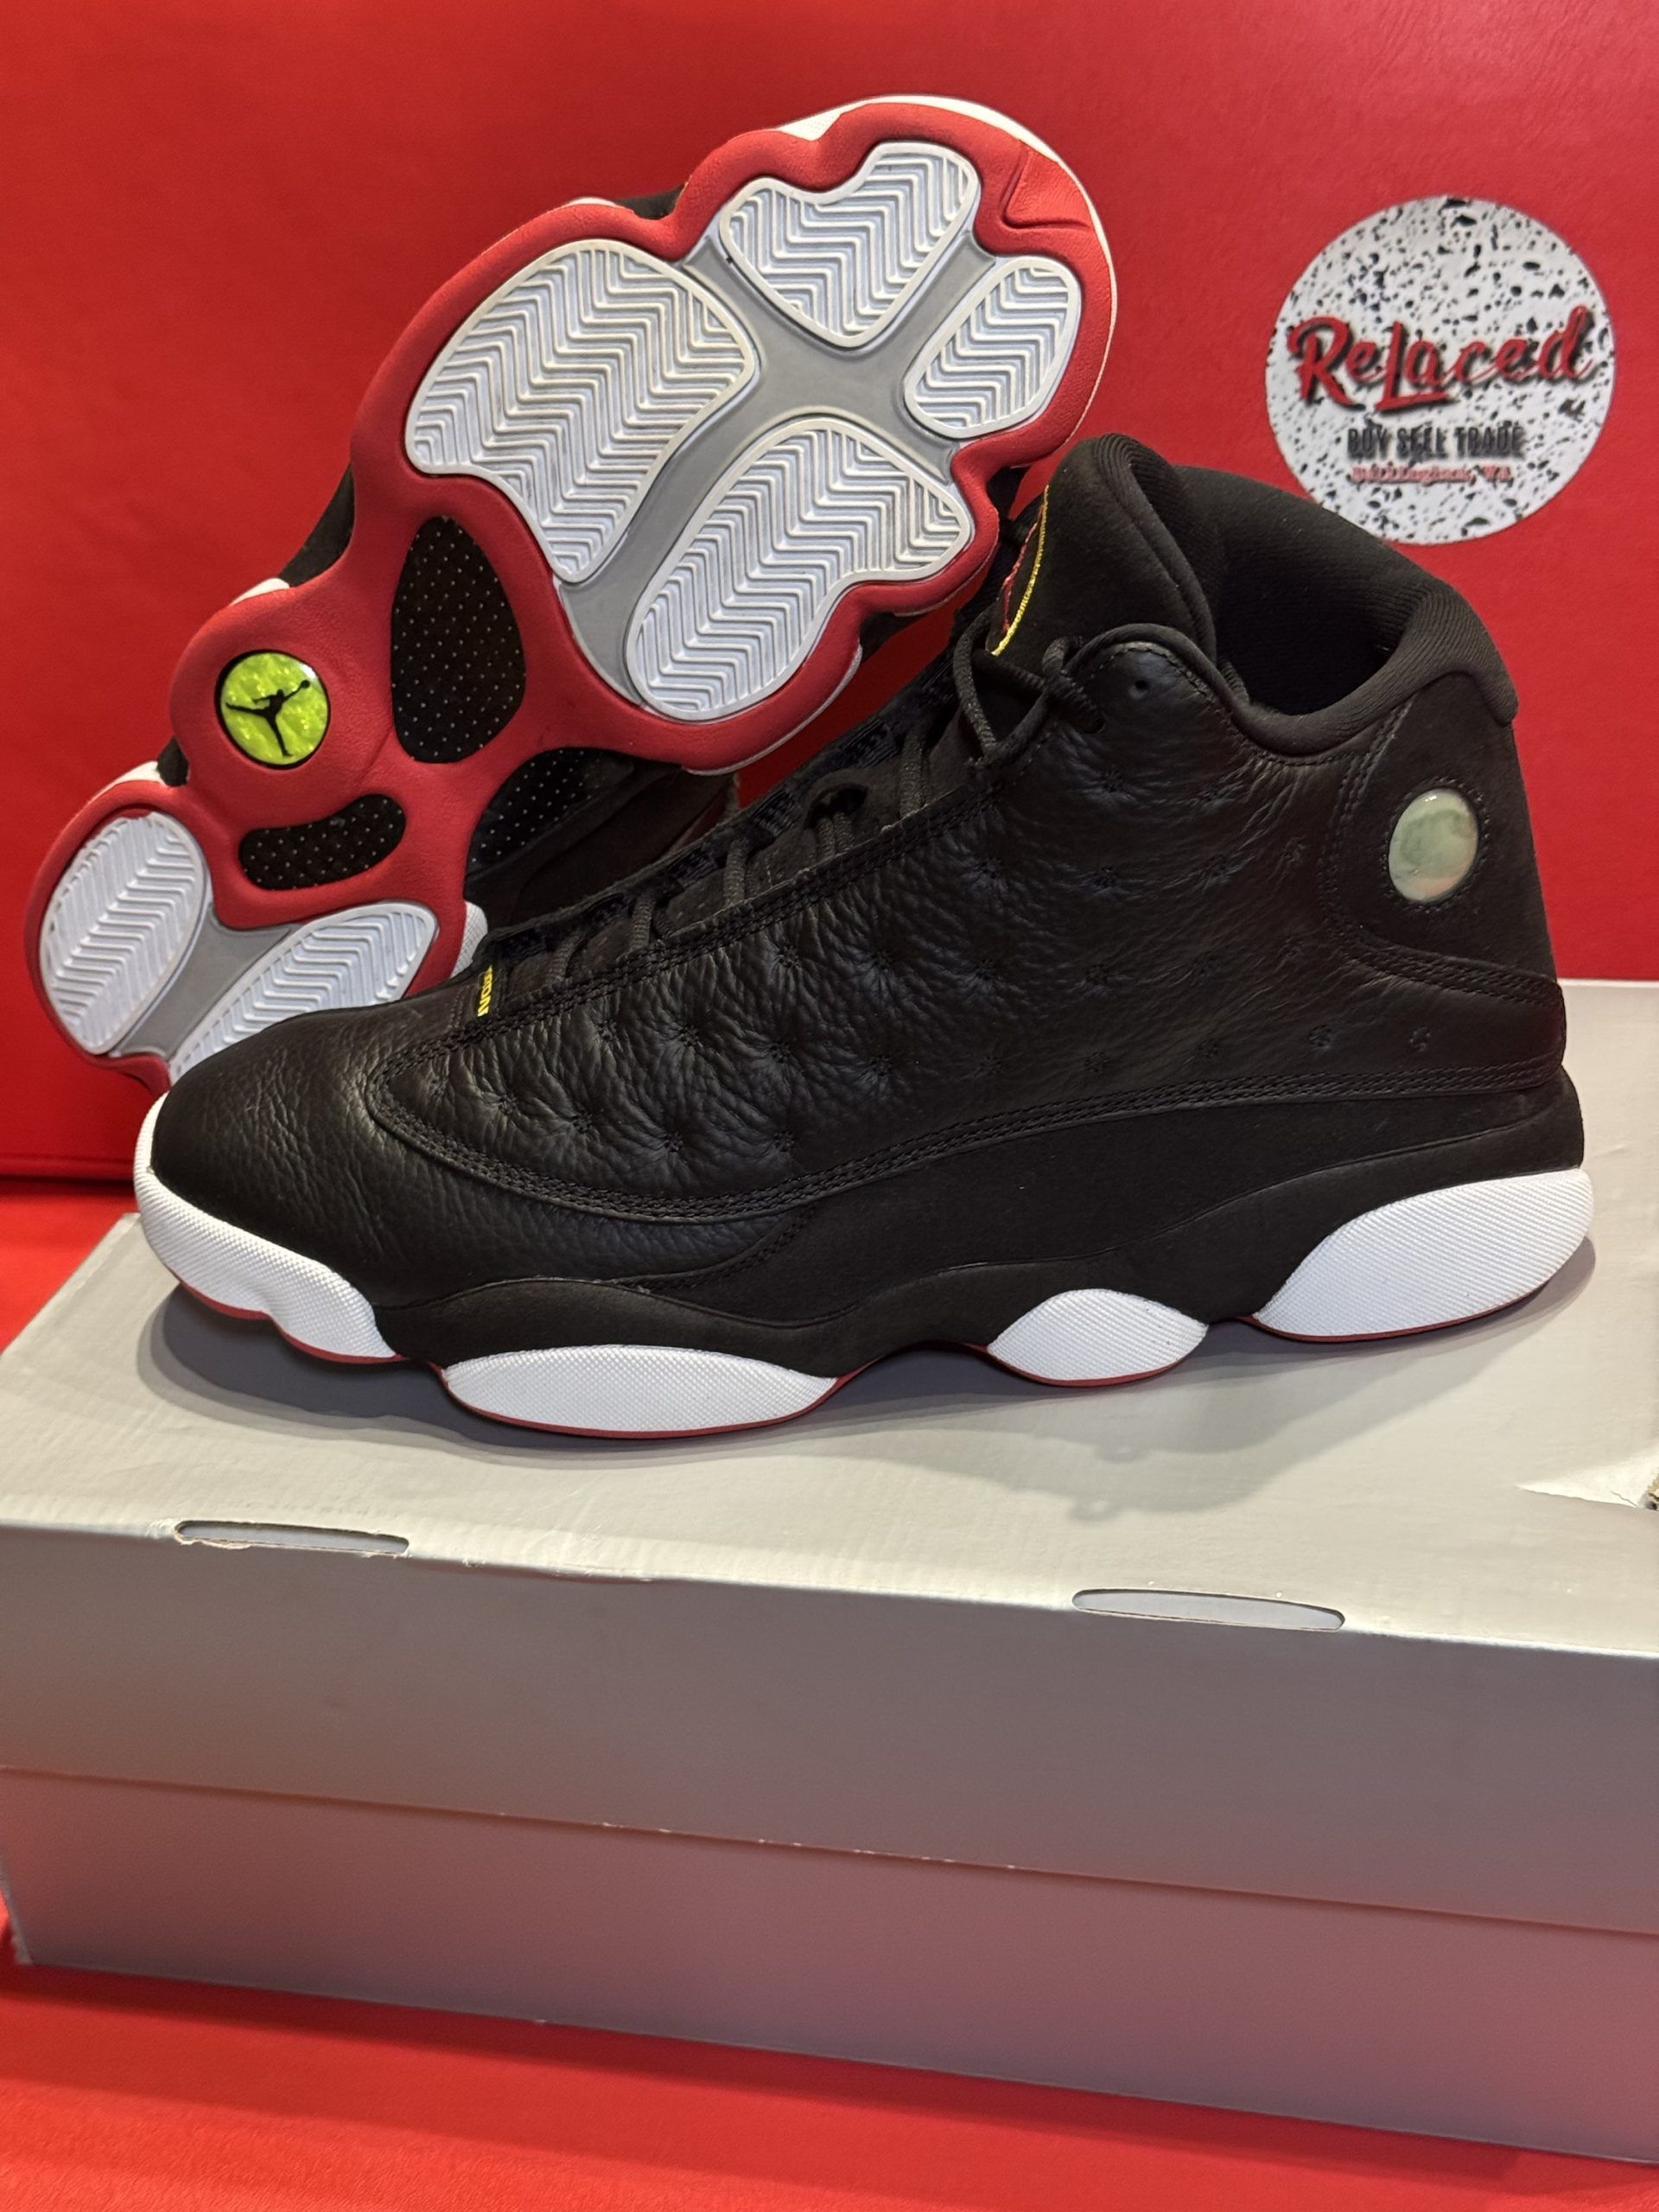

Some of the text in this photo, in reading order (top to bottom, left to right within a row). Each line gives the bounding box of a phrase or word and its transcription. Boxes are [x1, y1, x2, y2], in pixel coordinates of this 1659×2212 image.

[1348, 427, 1525, 460] BUY SELL TRADE
